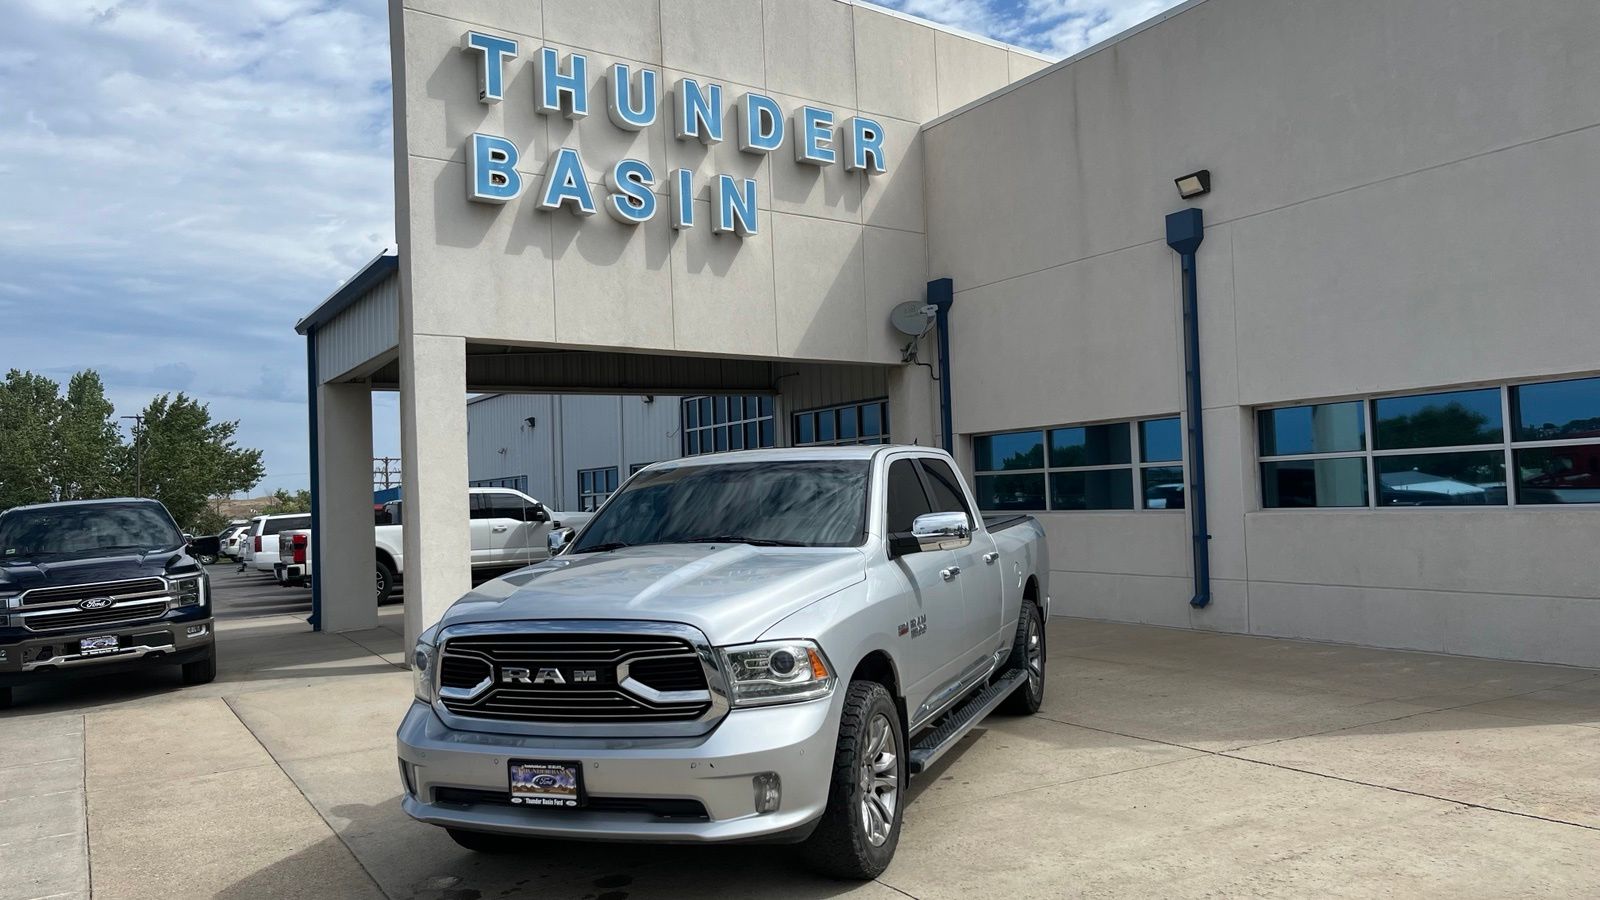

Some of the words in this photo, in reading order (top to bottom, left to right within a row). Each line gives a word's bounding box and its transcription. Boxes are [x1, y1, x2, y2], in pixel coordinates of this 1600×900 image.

[462, 31, 887, 174] THUNDER
[467, 133, 758, 237] BASIN
[525, 797, 542, 805] Thunder
